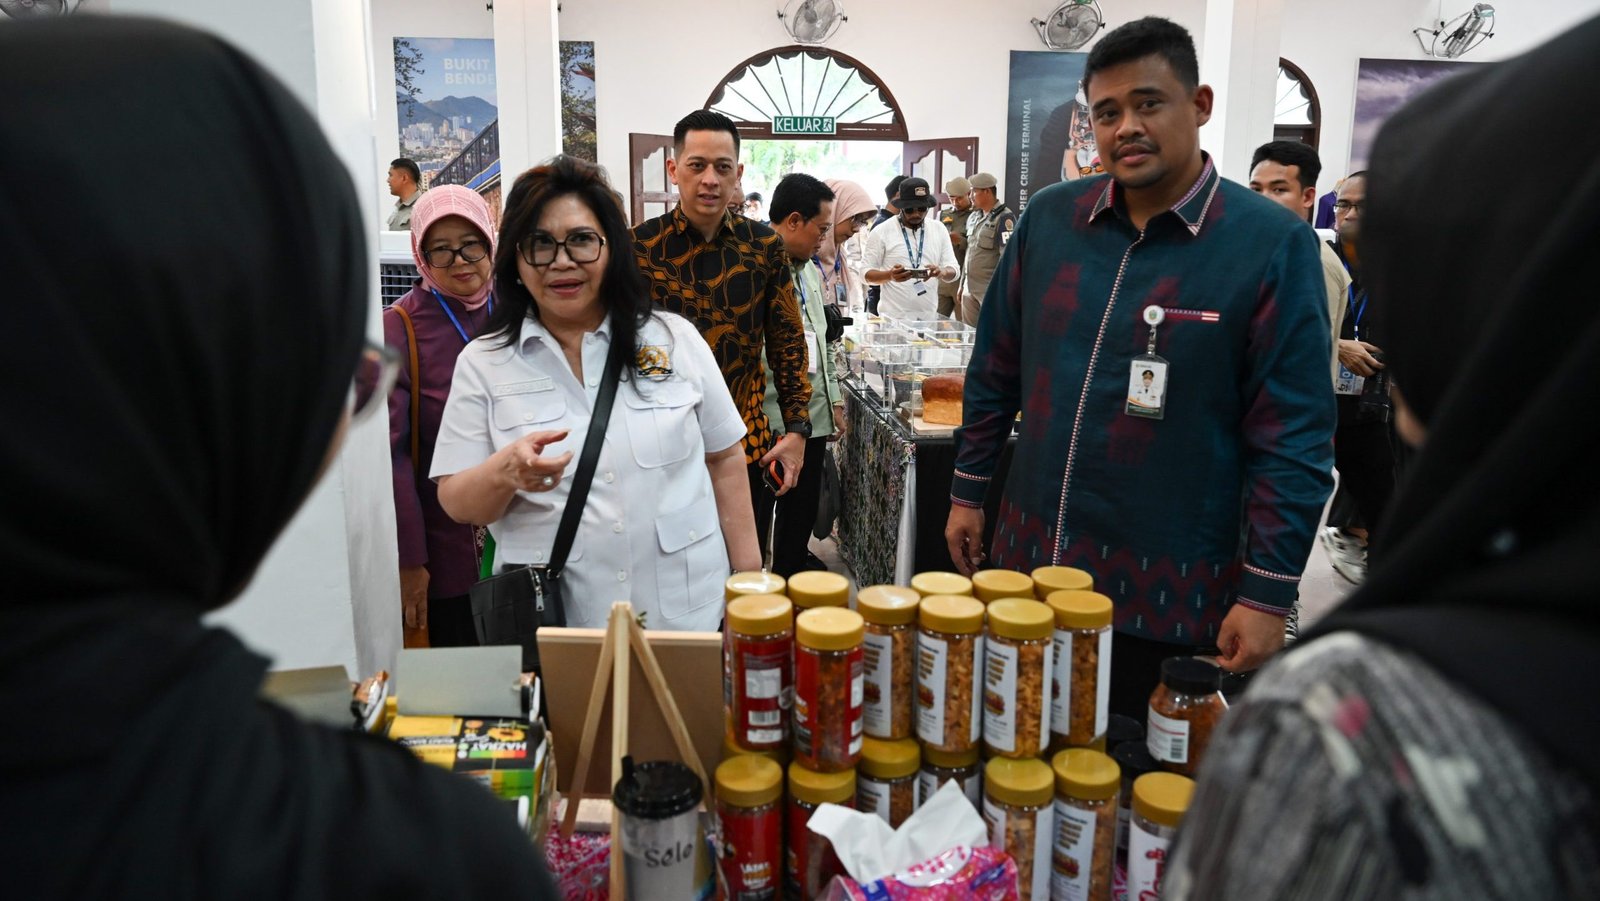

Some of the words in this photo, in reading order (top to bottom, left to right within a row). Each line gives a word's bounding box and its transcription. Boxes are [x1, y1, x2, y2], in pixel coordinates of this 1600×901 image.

[443, 58, 490, 71] BUKIT
[444, 73, 495, 85] BENDE
[776, 117, 821, 132] KELUAR
[1021, 98, 1032, 150] TERMINAL
[1020, 152, 1030, 187] CRUISE
[1019, 189, 1028, 211] PIER
